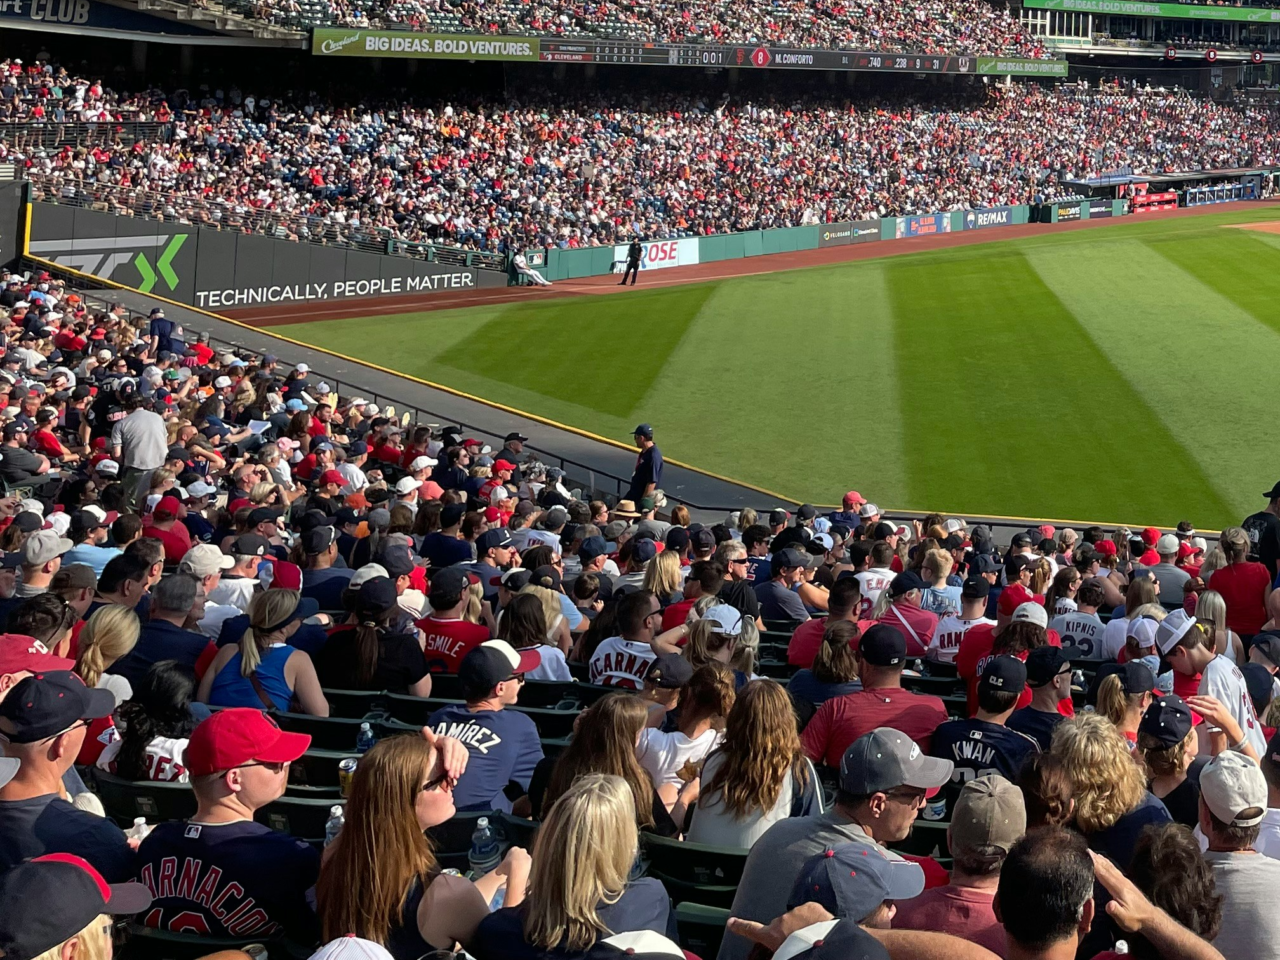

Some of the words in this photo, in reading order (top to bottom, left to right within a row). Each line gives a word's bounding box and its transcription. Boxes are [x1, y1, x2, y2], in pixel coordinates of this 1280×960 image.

[1074, 0, 1098, 11] IDEAS.
[1099, 1, 1119, 12] BOLD
[1119, 3, 1162, 14] VENTURES.
[321, 31, 360, 53] Cleveland
[365, 36, 390, 51] BIG
[391, 38, 432, 52] IDEAS.
[434, 40, 468, 54] BOLD
[469, 41, 532, 56] VENTURES.
[758, 51, 764, 64] 8
[868, 57, 881, 67] .740
[893, 58, 907, 68] .238
[932, 59, 939, 69] 31
[977, 210, 1008, 226] RE/MAX
[641, 241, 678, 269] ROSE
[196, 283, 327, 307] TECHNICALLY,
[333, 277, 401, 297] PEOPLE
[406, 272, 474, 291] MATTER.
[939, 628, 968, 649] RAM
[1065, 620, 1097, 637] KIPNIS
[427, 634, 465, 657] SMILE
[428, 719, 501, 754] AMÍREZ
[952, 740, 996, 764] KWAN
[128, 856, 285, 938] ARNACIO
